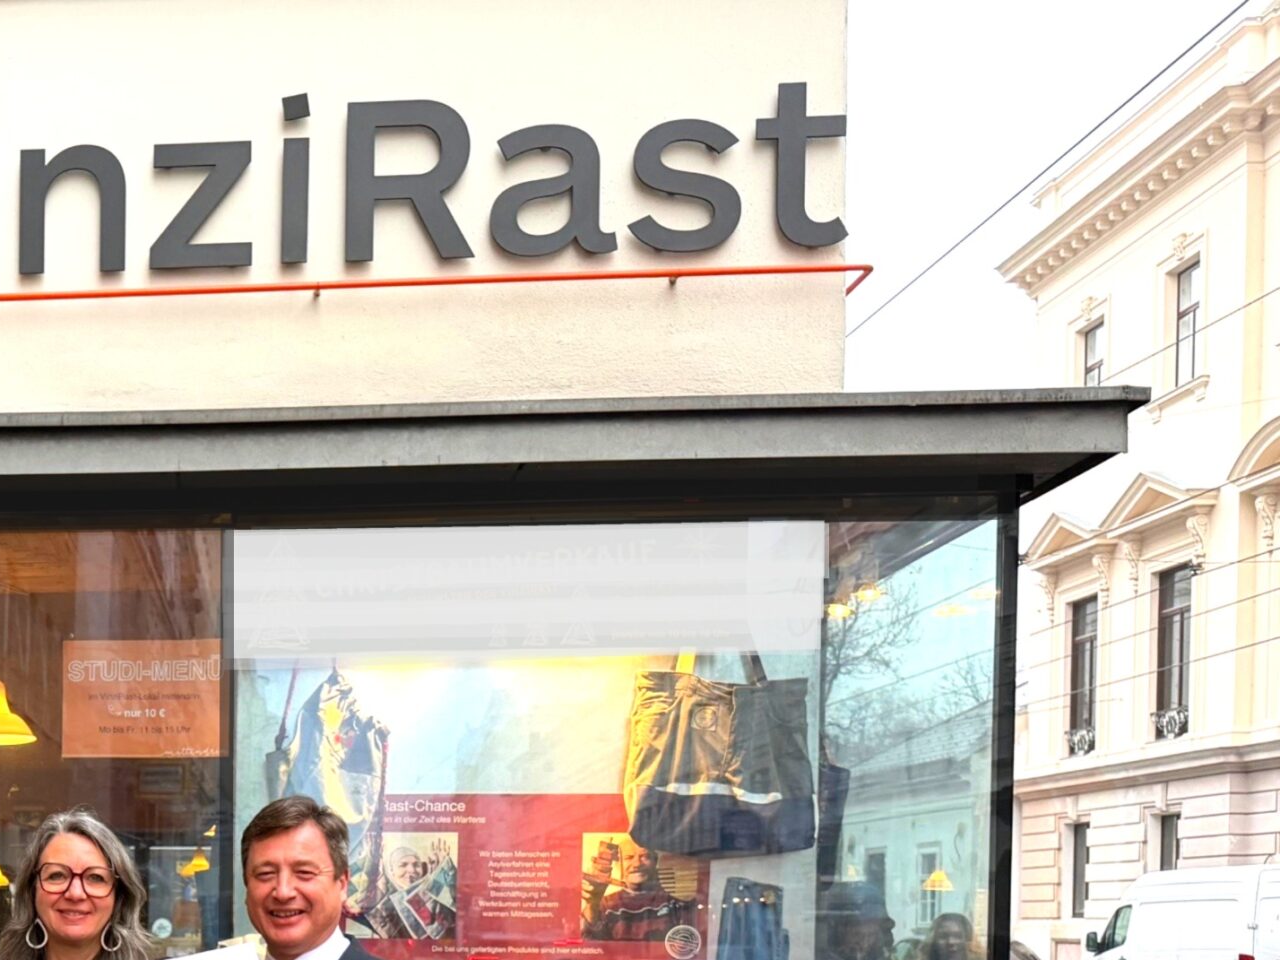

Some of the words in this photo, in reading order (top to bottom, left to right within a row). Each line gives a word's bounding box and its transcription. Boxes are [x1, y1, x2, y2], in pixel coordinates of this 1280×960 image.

[67, 655, 224, 682] STUDI-MENÜ
[123, 709, 141, 718] nur
[144, 708, 156, 718] 10
[158, 708, 166, 718] €
